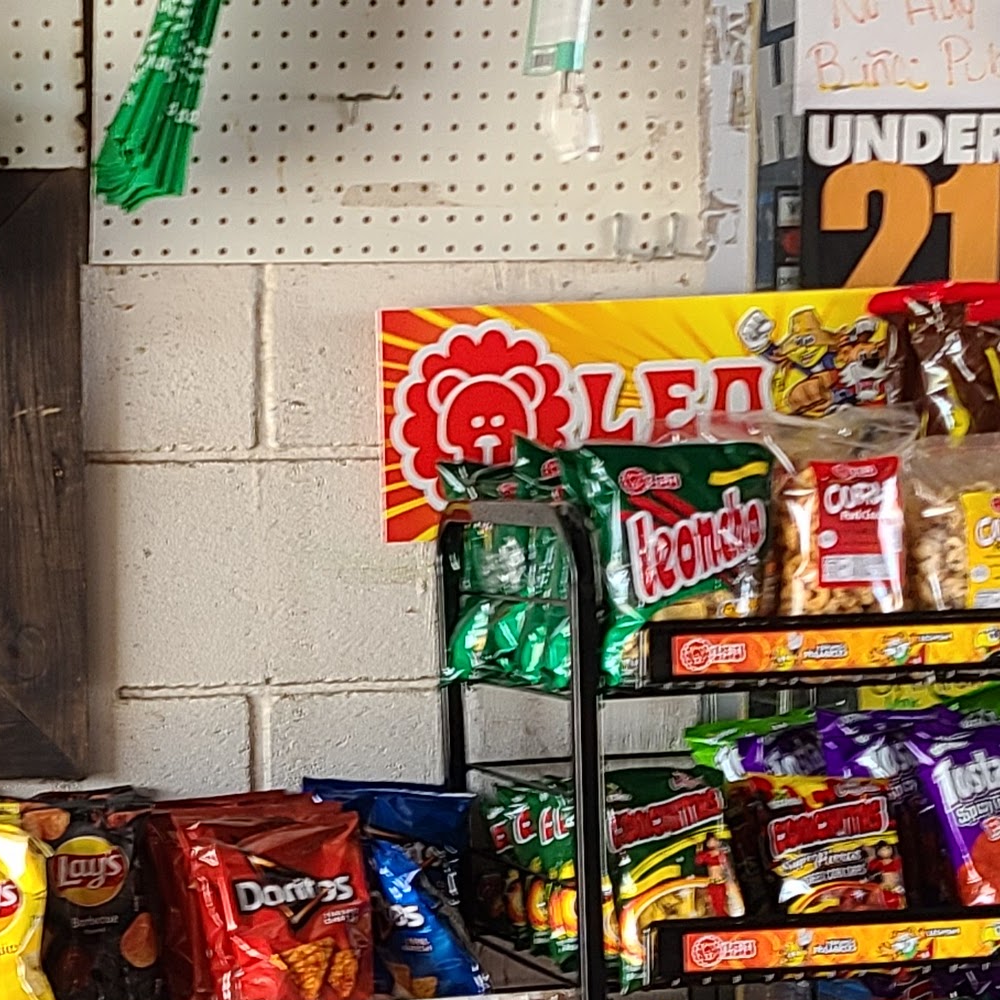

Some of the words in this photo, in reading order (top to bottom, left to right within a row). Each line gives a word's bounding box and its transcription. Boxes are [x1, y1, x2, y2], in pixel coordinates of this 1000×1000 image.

[821, 161, 998, 289] 21
[56, 848, 124, 889] Lay's
[234, 874, 354, 912] Doritos
